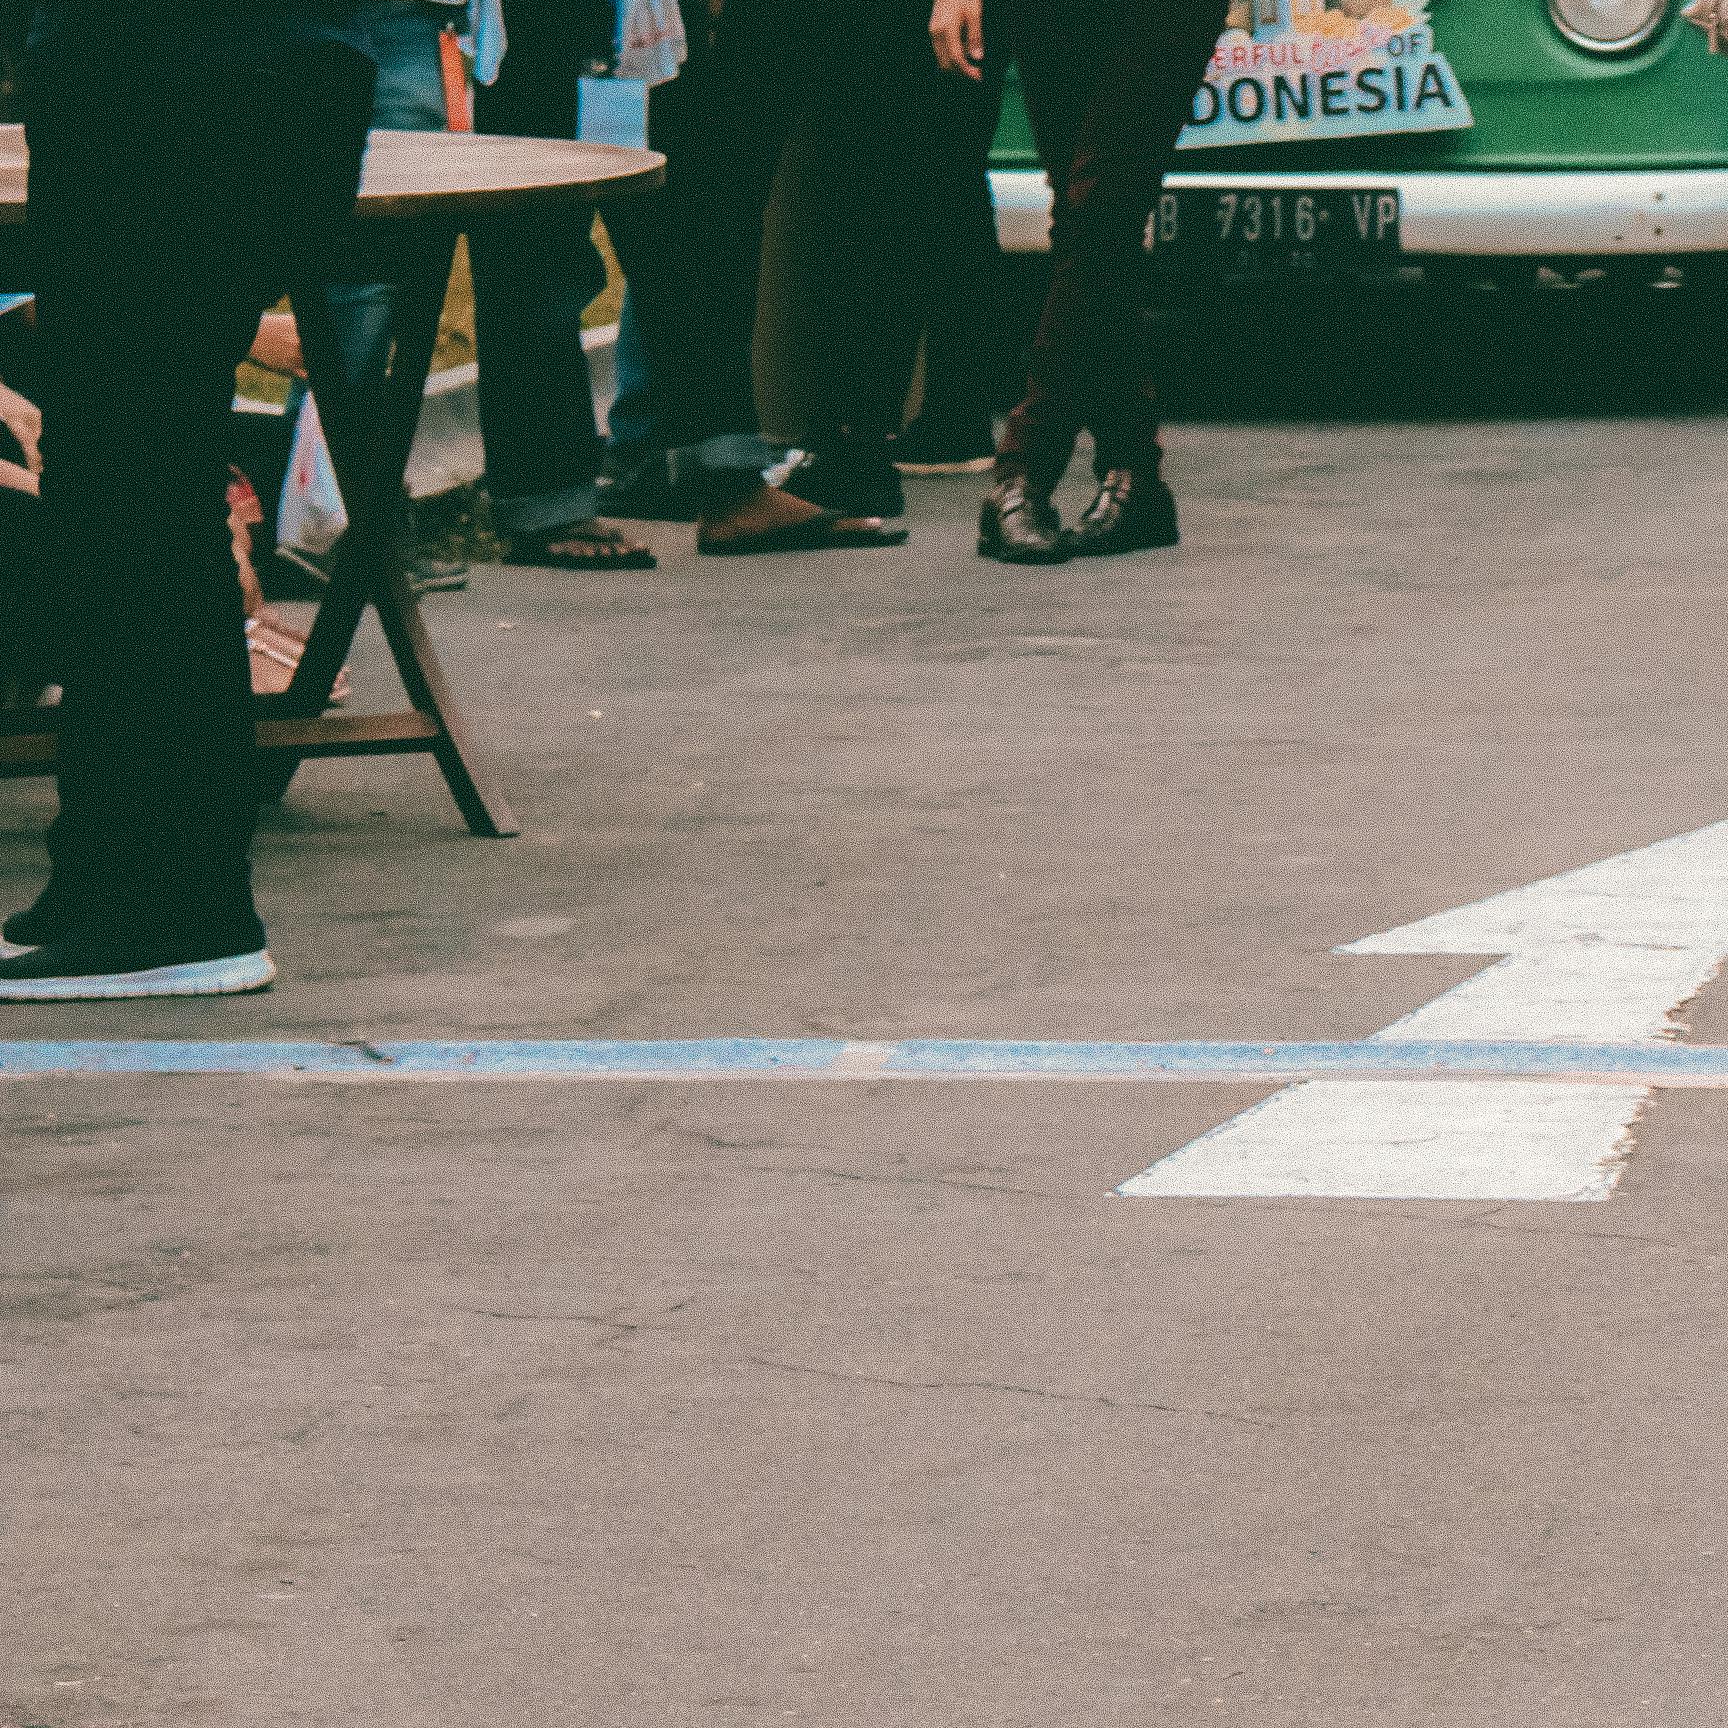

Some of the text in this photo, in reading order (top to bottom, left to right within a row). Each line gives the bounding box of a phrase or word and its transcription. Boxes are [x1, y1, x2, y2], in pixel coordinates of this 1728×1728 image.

[1386, 32, 1423, 58] OF
[1160, 194, 1397, 242] B 7316 VP
